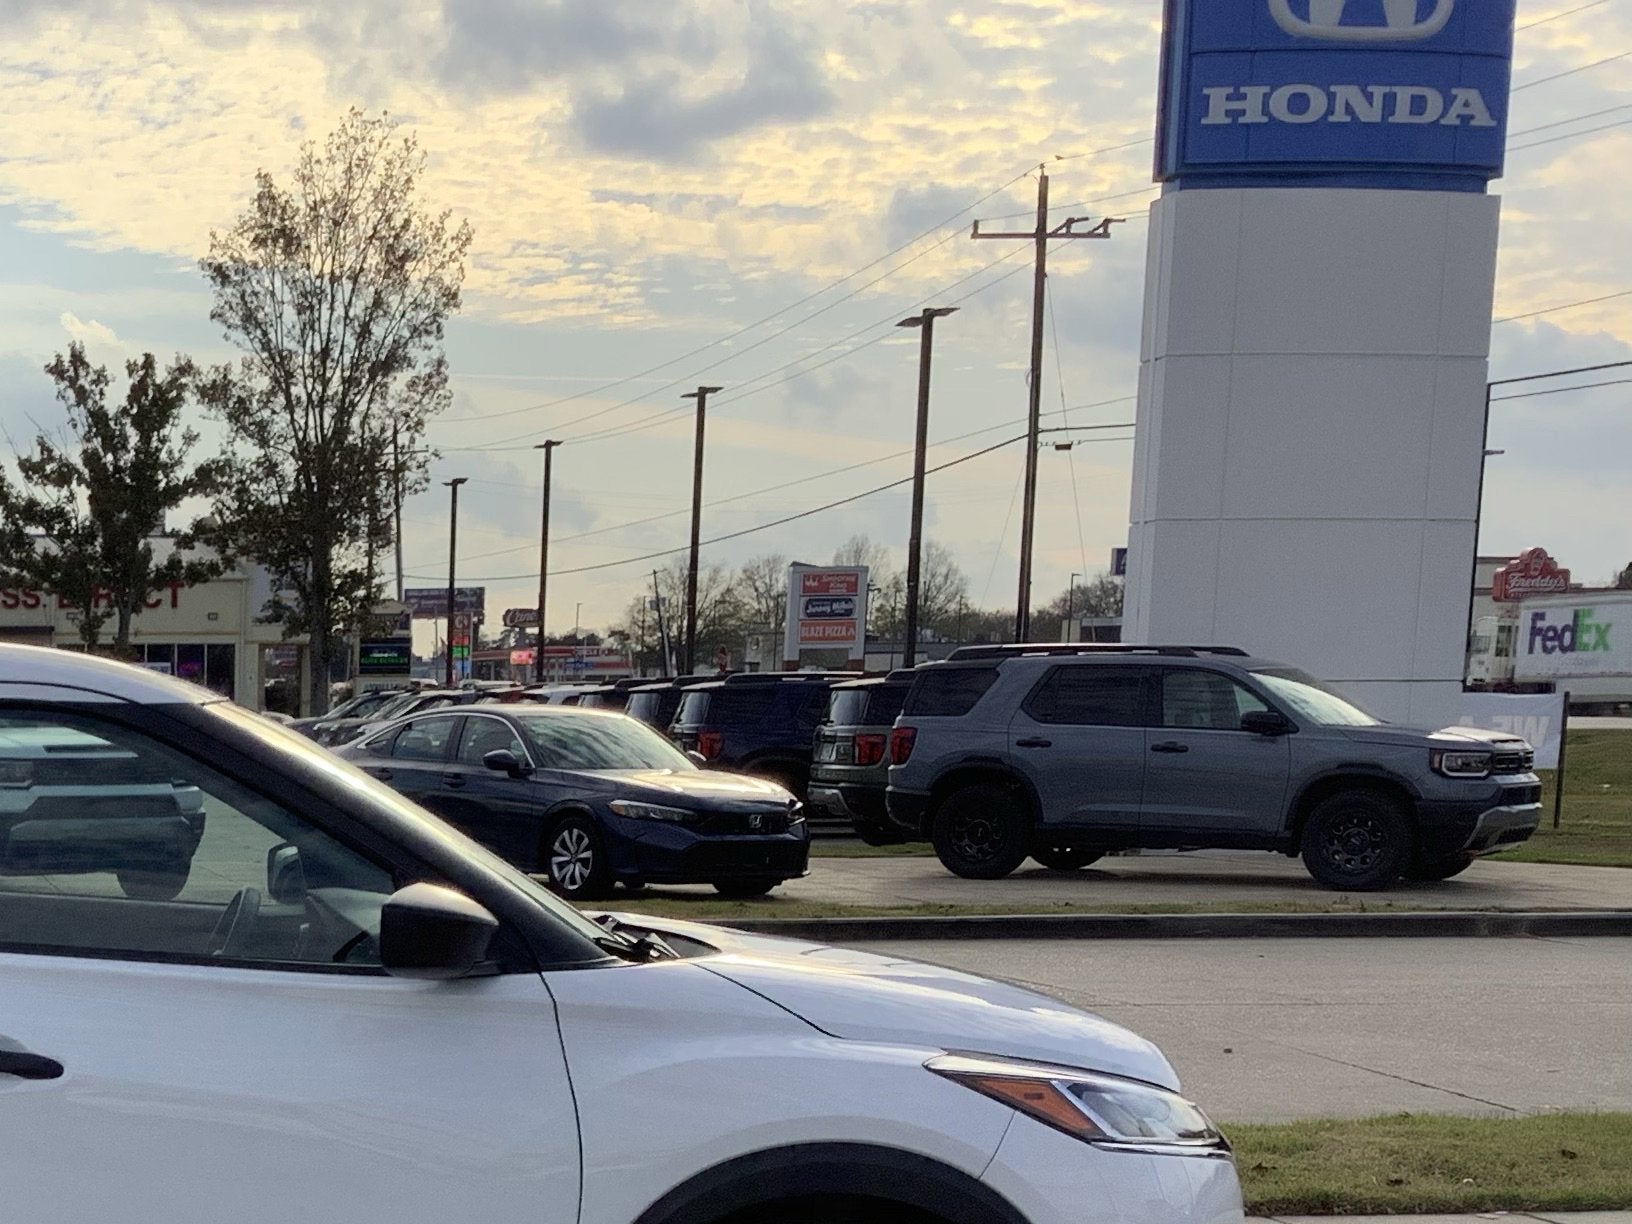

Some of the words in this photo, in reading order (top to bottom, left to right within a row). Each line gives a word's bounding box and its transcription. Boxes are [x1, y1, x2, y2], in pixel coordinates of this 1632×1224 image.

[1200, 84, 1498, 127] HONDA
[1507, 572, 1566, 593] Freddy's
[1528, 608, 1612, 654] FedEx
